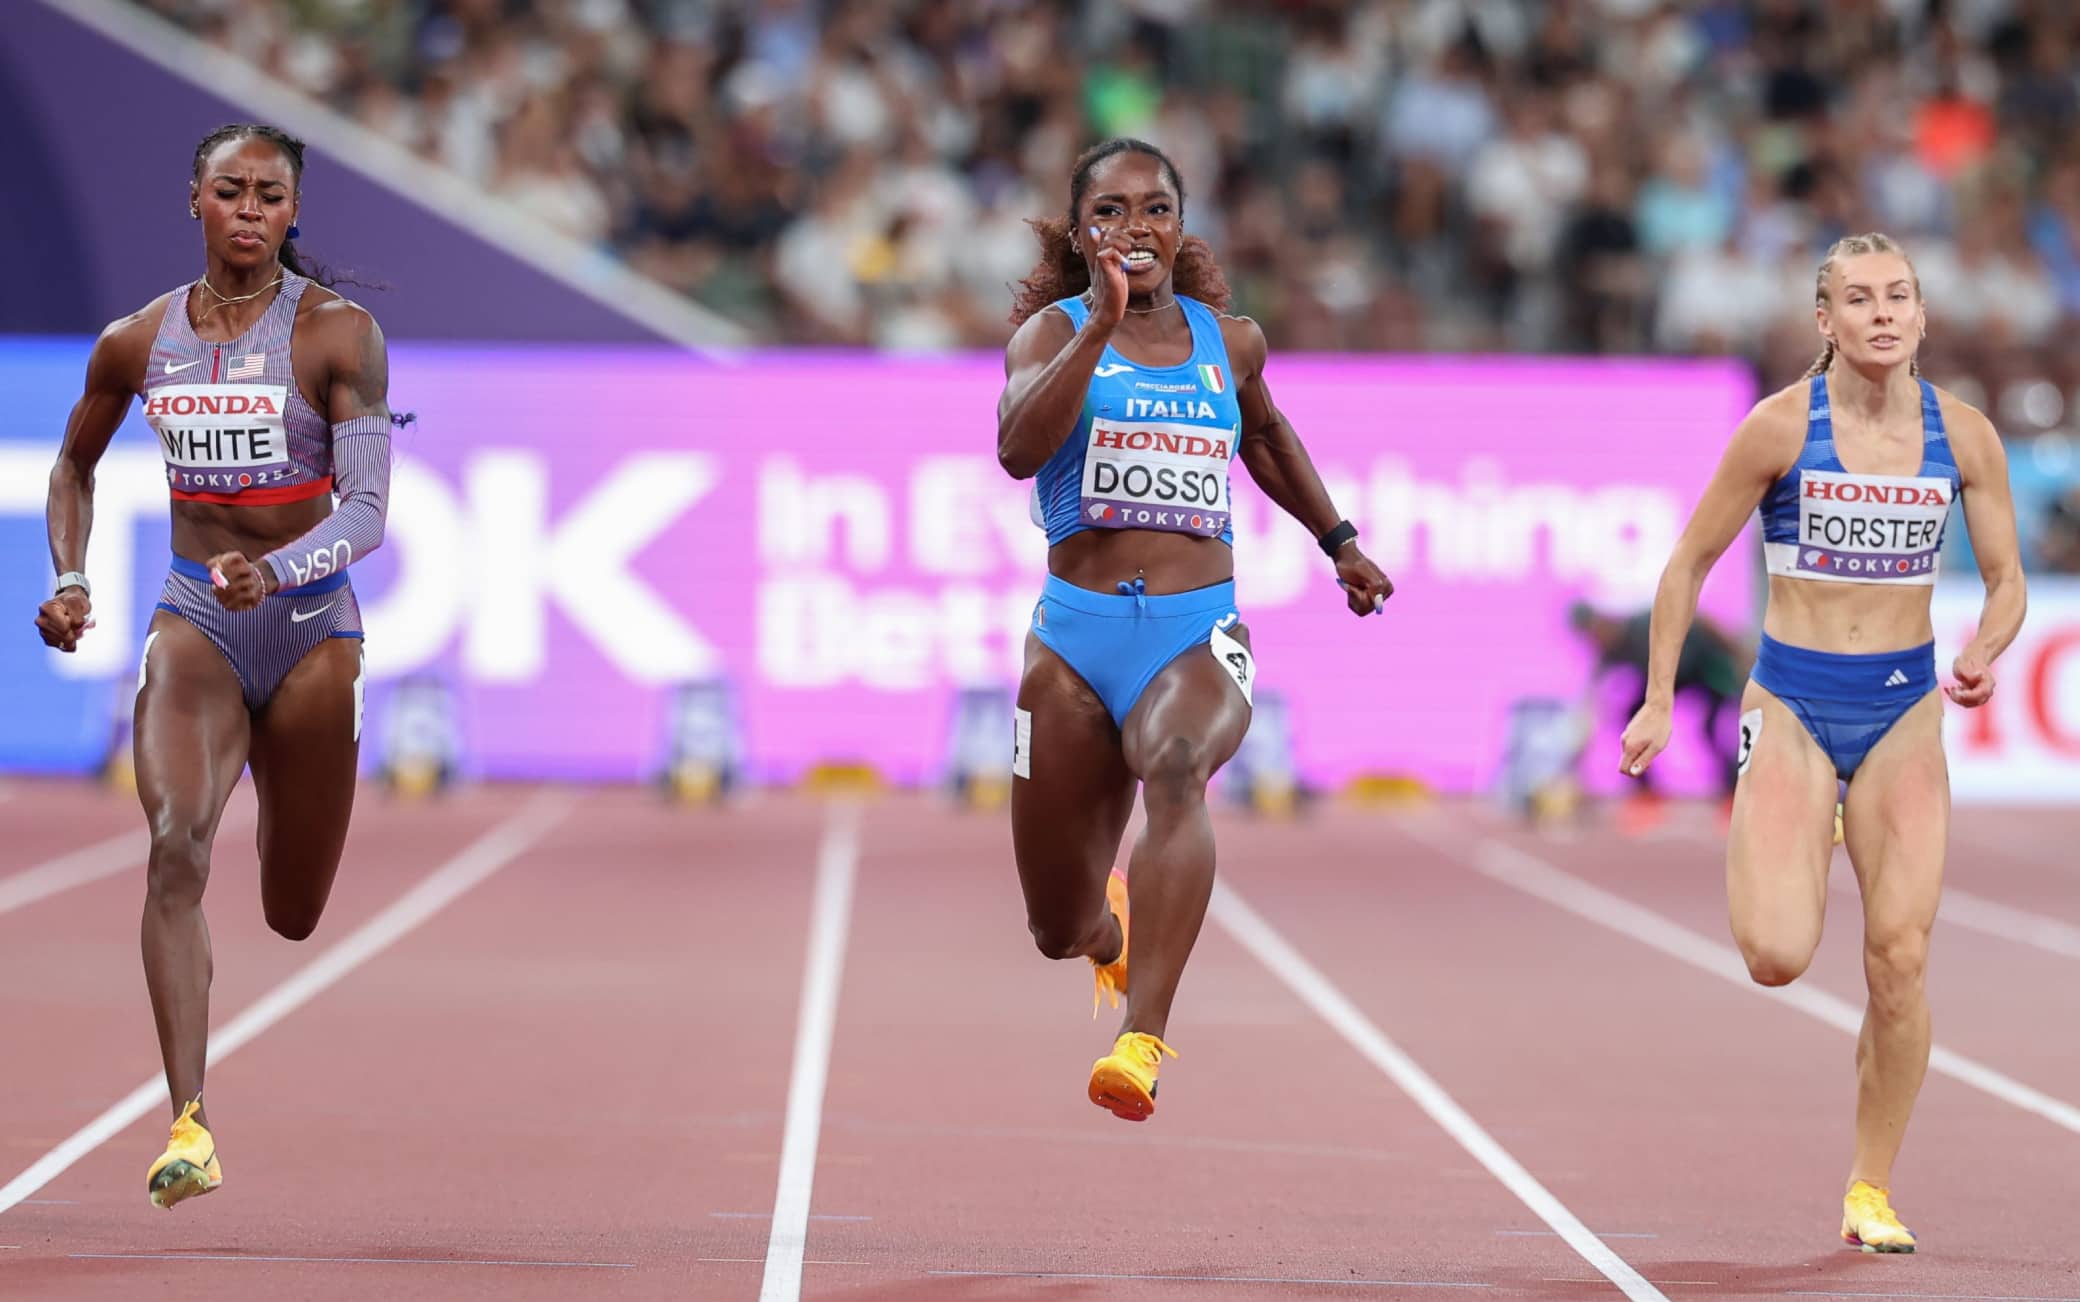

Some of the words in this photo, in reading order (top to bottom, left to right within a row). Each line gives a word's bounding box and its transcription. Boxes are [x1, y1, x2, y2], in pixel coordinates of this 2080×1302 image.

[145, 395, 279, 416] HONDA
[1126, 398, 1217, 420] ITALIA
[160, 428, 273, 461] WHITE
[1092, 428, 1229, 460] HONDA
[1093, 461, 1220, 506] DOSSO
[1803, 480, 1947, 506] HONDA
[1808, 513, 1937, 548] FORSTER
[289, 538, 352, 587] USA
